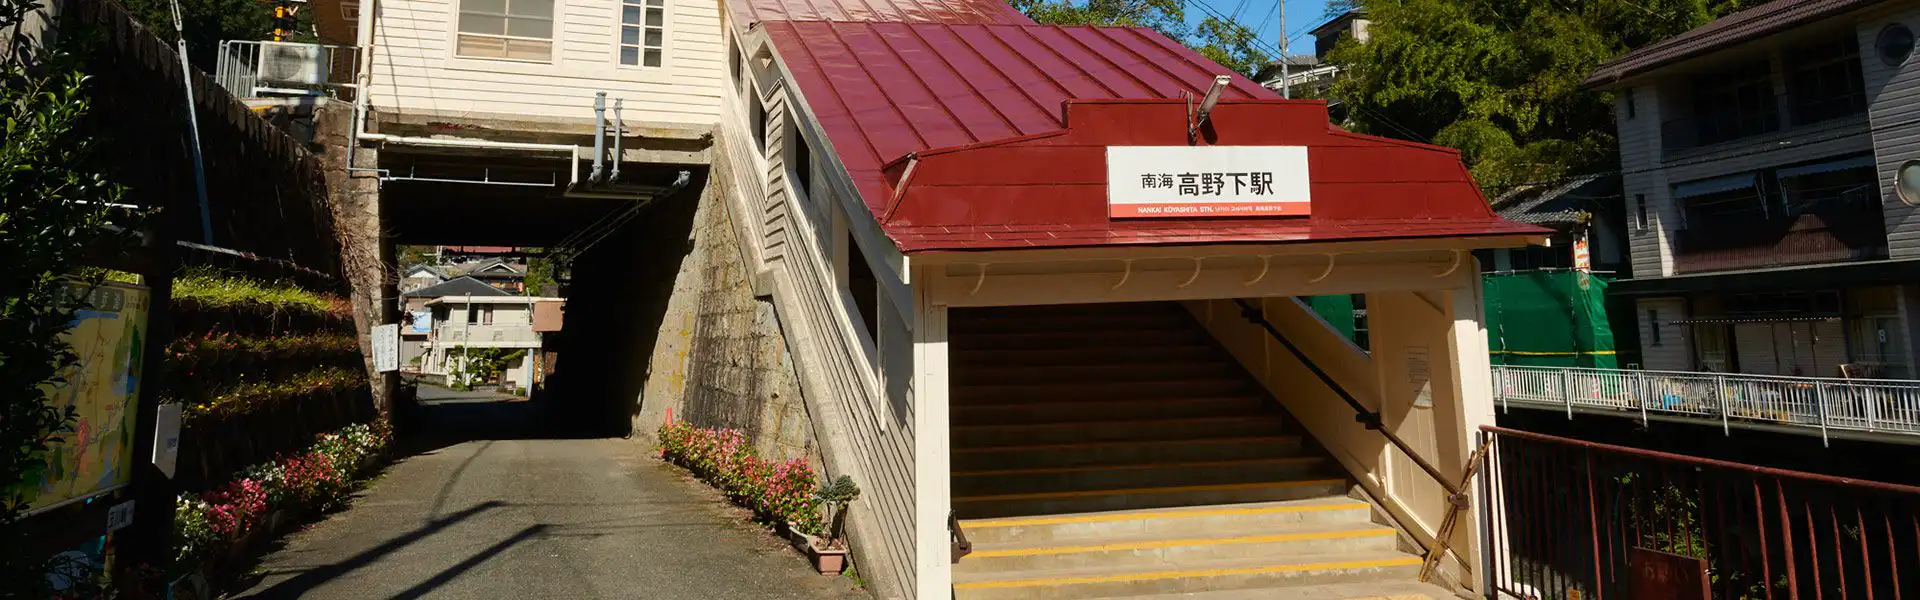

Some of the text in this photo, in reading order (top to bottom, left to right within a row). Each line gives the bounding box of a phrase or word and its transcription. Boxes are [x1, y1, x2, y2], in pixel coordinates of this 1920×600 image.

[1141, 172, 1274, 196] 南海 高野下駅
[1137, 206, 1162, 214] NANKAI
